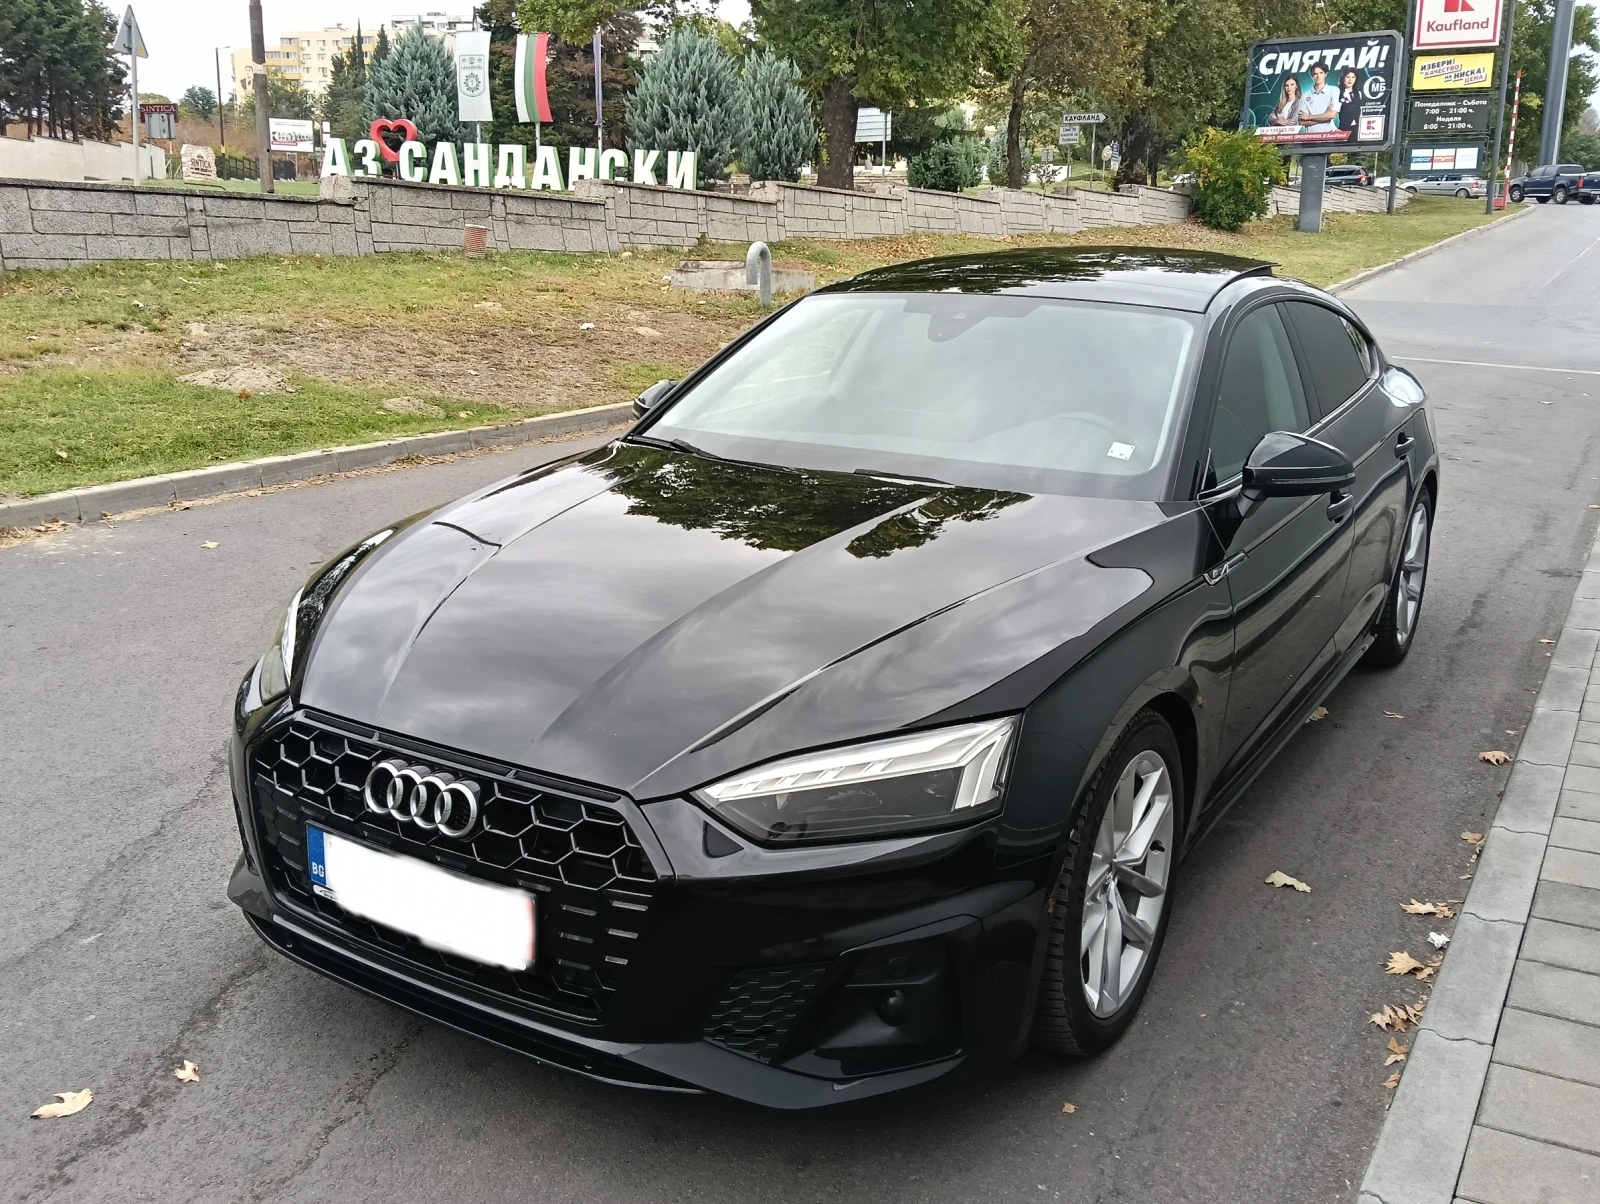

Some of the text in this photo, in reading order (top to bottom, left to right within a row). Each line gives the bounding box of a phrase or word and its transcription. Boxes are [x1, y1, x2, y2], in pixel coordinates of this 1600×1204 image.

[1427, 17, 1489, 32] Kaufland
[1259, 39, 1390, 75] СМЯТАЙ!
[1425, 64, 1460, 76] КАЧЕСТВО
[1465, 75, 1484, 83] ЦЕНА
[320, 137, 698, 190] АЗ САНДАНСКИ
[311, 861, 325, 878] BG
